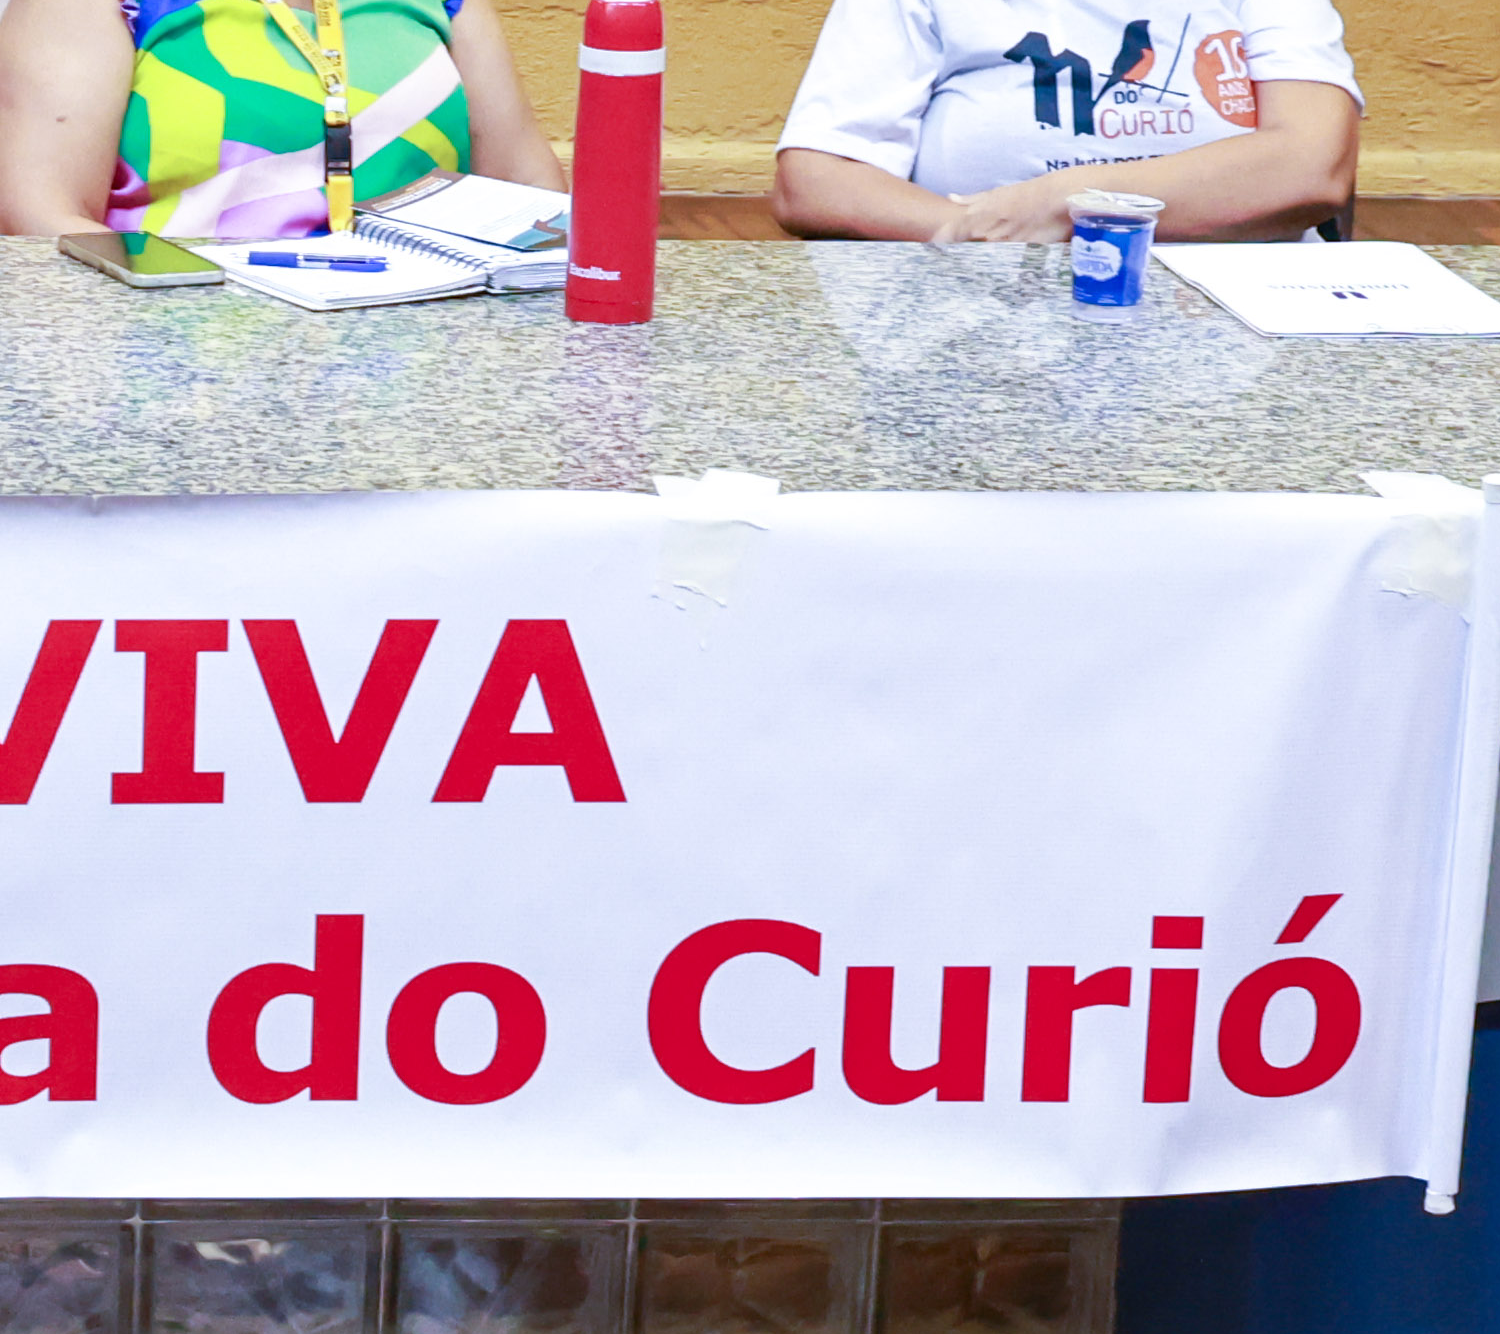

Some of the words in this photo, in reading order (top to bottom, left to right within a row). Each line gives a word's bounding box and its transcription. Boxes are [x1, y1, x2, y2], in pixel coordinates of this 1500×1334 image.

[1114, 90, 1139, 105] DO
[207, 913, 547, 1106] do
[647, 893, 1363, 1106] Curió
